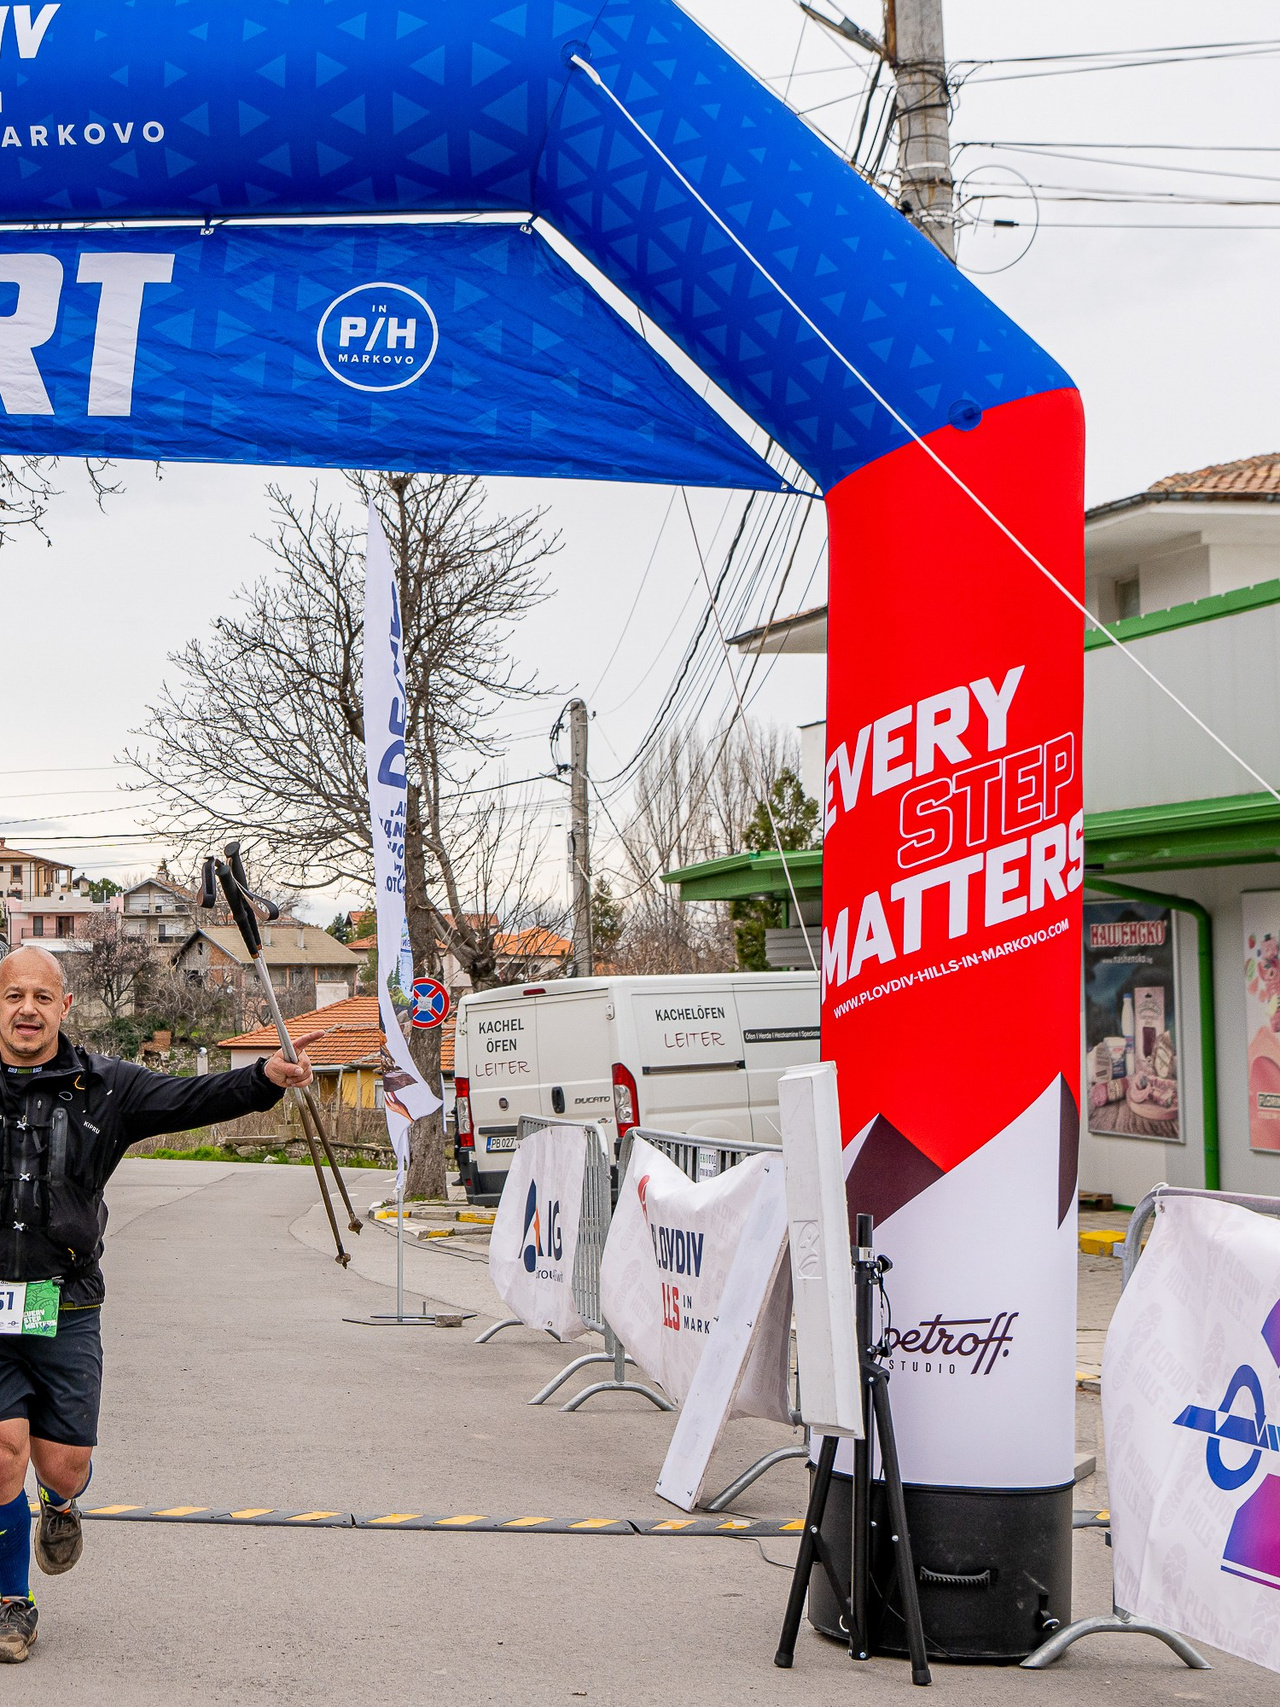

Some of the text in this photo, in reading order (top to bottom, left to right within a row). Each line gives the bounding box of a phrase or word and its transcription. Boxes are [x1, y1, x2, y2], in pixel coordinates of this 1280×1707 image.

[372, 304, 387, 313] IN
[339, 316, 417, 352] P/H
[338, 354, 414, 365] MARKOVO
[824, 665, 1025, 840] EVERY
[897, 731, 1075, 870] STEP
[821, 808, 1084, 1005] MATTERS
[833, 918, 1070, 1019] WWW.PLOVDIV-HILLS-IN-MARKOVO.COM
[655, 1004, 725, 1022] KACHELÖFEN
[478, 1018, 525, 1036] KACHEL
[486, 1037, 517, 1053] ÖFEN
[664, 1031, 726, 1049] LEITER
[475, 1060, 531, 1078] LEITER
[575, 1096, 610, 1105] DUCATO
[491, 1138, 516, 1149] PB 027
[651, 1223, 704, 1277] POVDIV
[683, 1295, 692, 1309] IN
[889, 1359, 956, 1375] STUDIO
